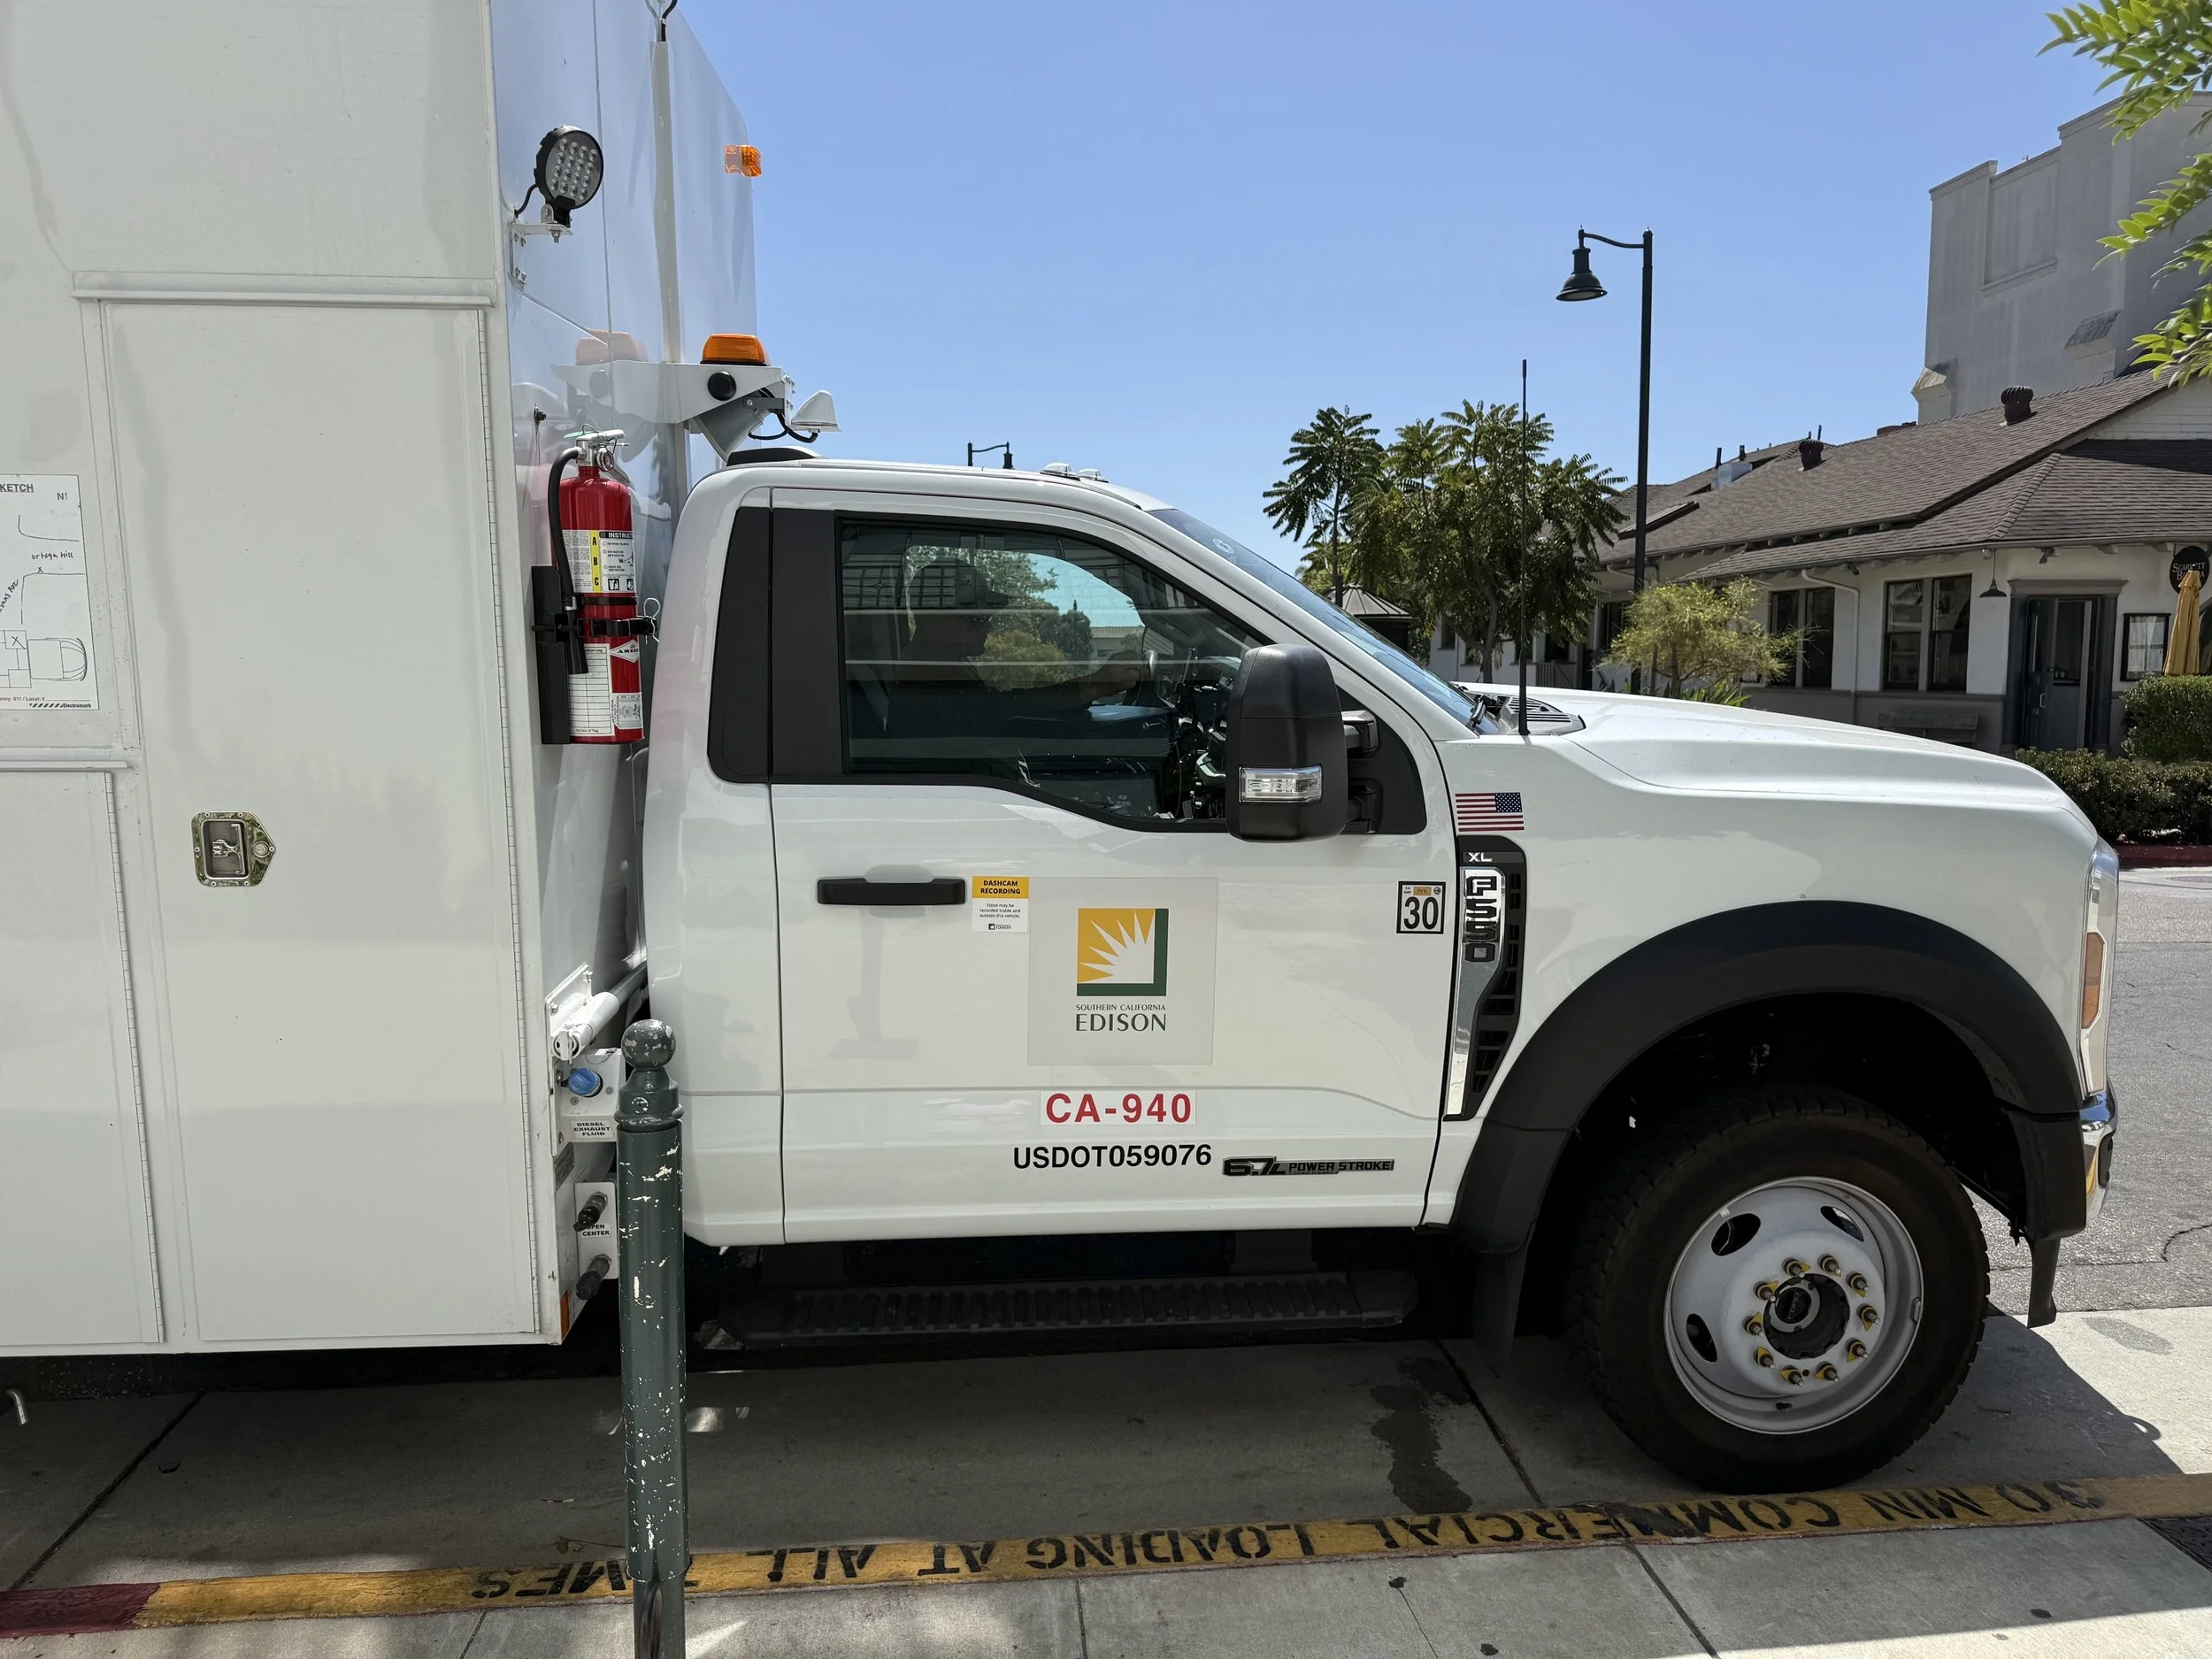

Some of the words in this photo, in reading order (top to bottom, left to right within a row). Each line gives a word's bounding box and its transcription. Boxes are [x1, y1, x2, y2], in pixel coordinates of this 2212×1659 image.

[592, 536, 597, 546] A
[593, 557, 598, 566] B
[594, 577, 599, 586] C
[1468, 852, 1493, 862] XL
[1403, 896, 1439, 930] 30
[1464, 875, 1497, 963] F550
[1075, 1012, 1166, 1032] EDISON
[1045, 1093, 1192, 1123] CA-940
[1012, 1143, 1212, 1169] USDOT059076
[1223, 1156, 1286, 1176] 6.7L
[1288, 1162, 1335, 1171] POWER
[1338, 1160, 1391, 1171] STROKE
[1861, 1486, 1994, 1522] MIN
[1994, 1479, 2105, 1514] 30
[917, 1541, 996, 1577] AT
[1025, 1524, 1315, 1570] LOADING
[747, 1545, 877, 1583] ALL
